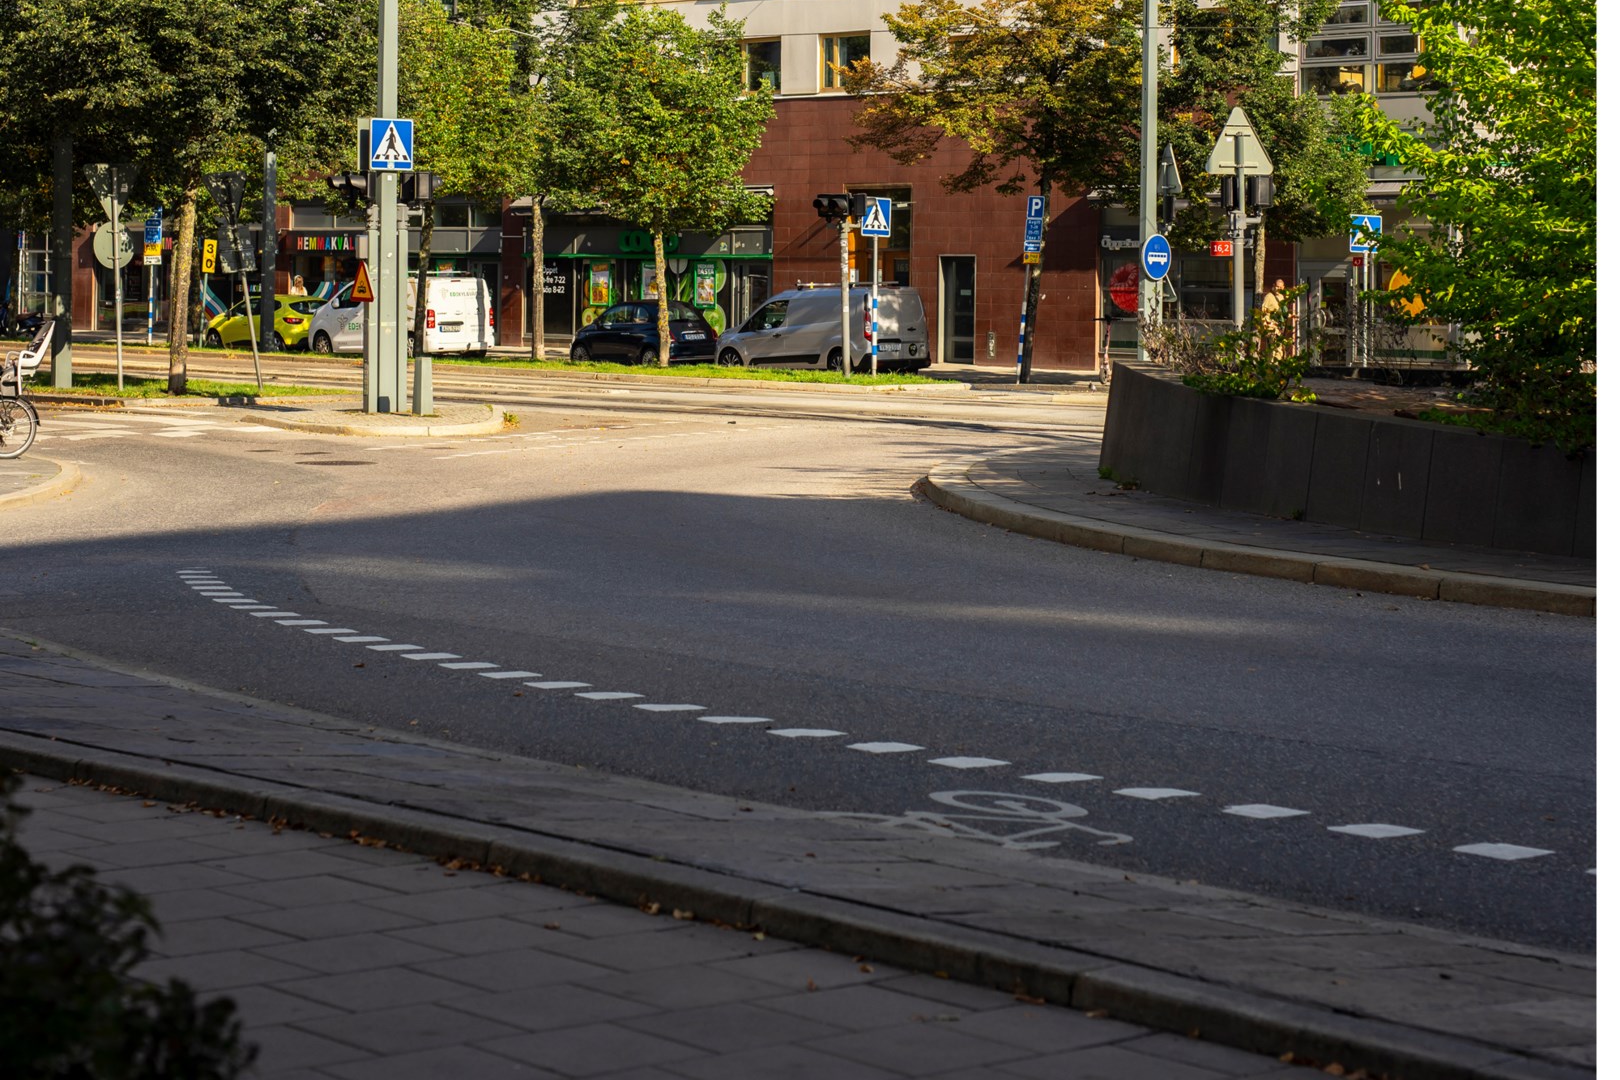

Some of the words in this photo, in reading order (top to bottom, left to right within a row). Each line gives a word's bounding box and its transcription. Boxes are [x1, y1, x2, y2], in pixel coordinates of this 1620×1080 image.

[1032, 198, 1042, 217] P
[297, 233, 355, 250] HEMMAKVÄL
[1213, 244, 1230, 254] 16,2
[554, 276, 566, 284] 7-22
[552, 286, 565, 294] 8-22
